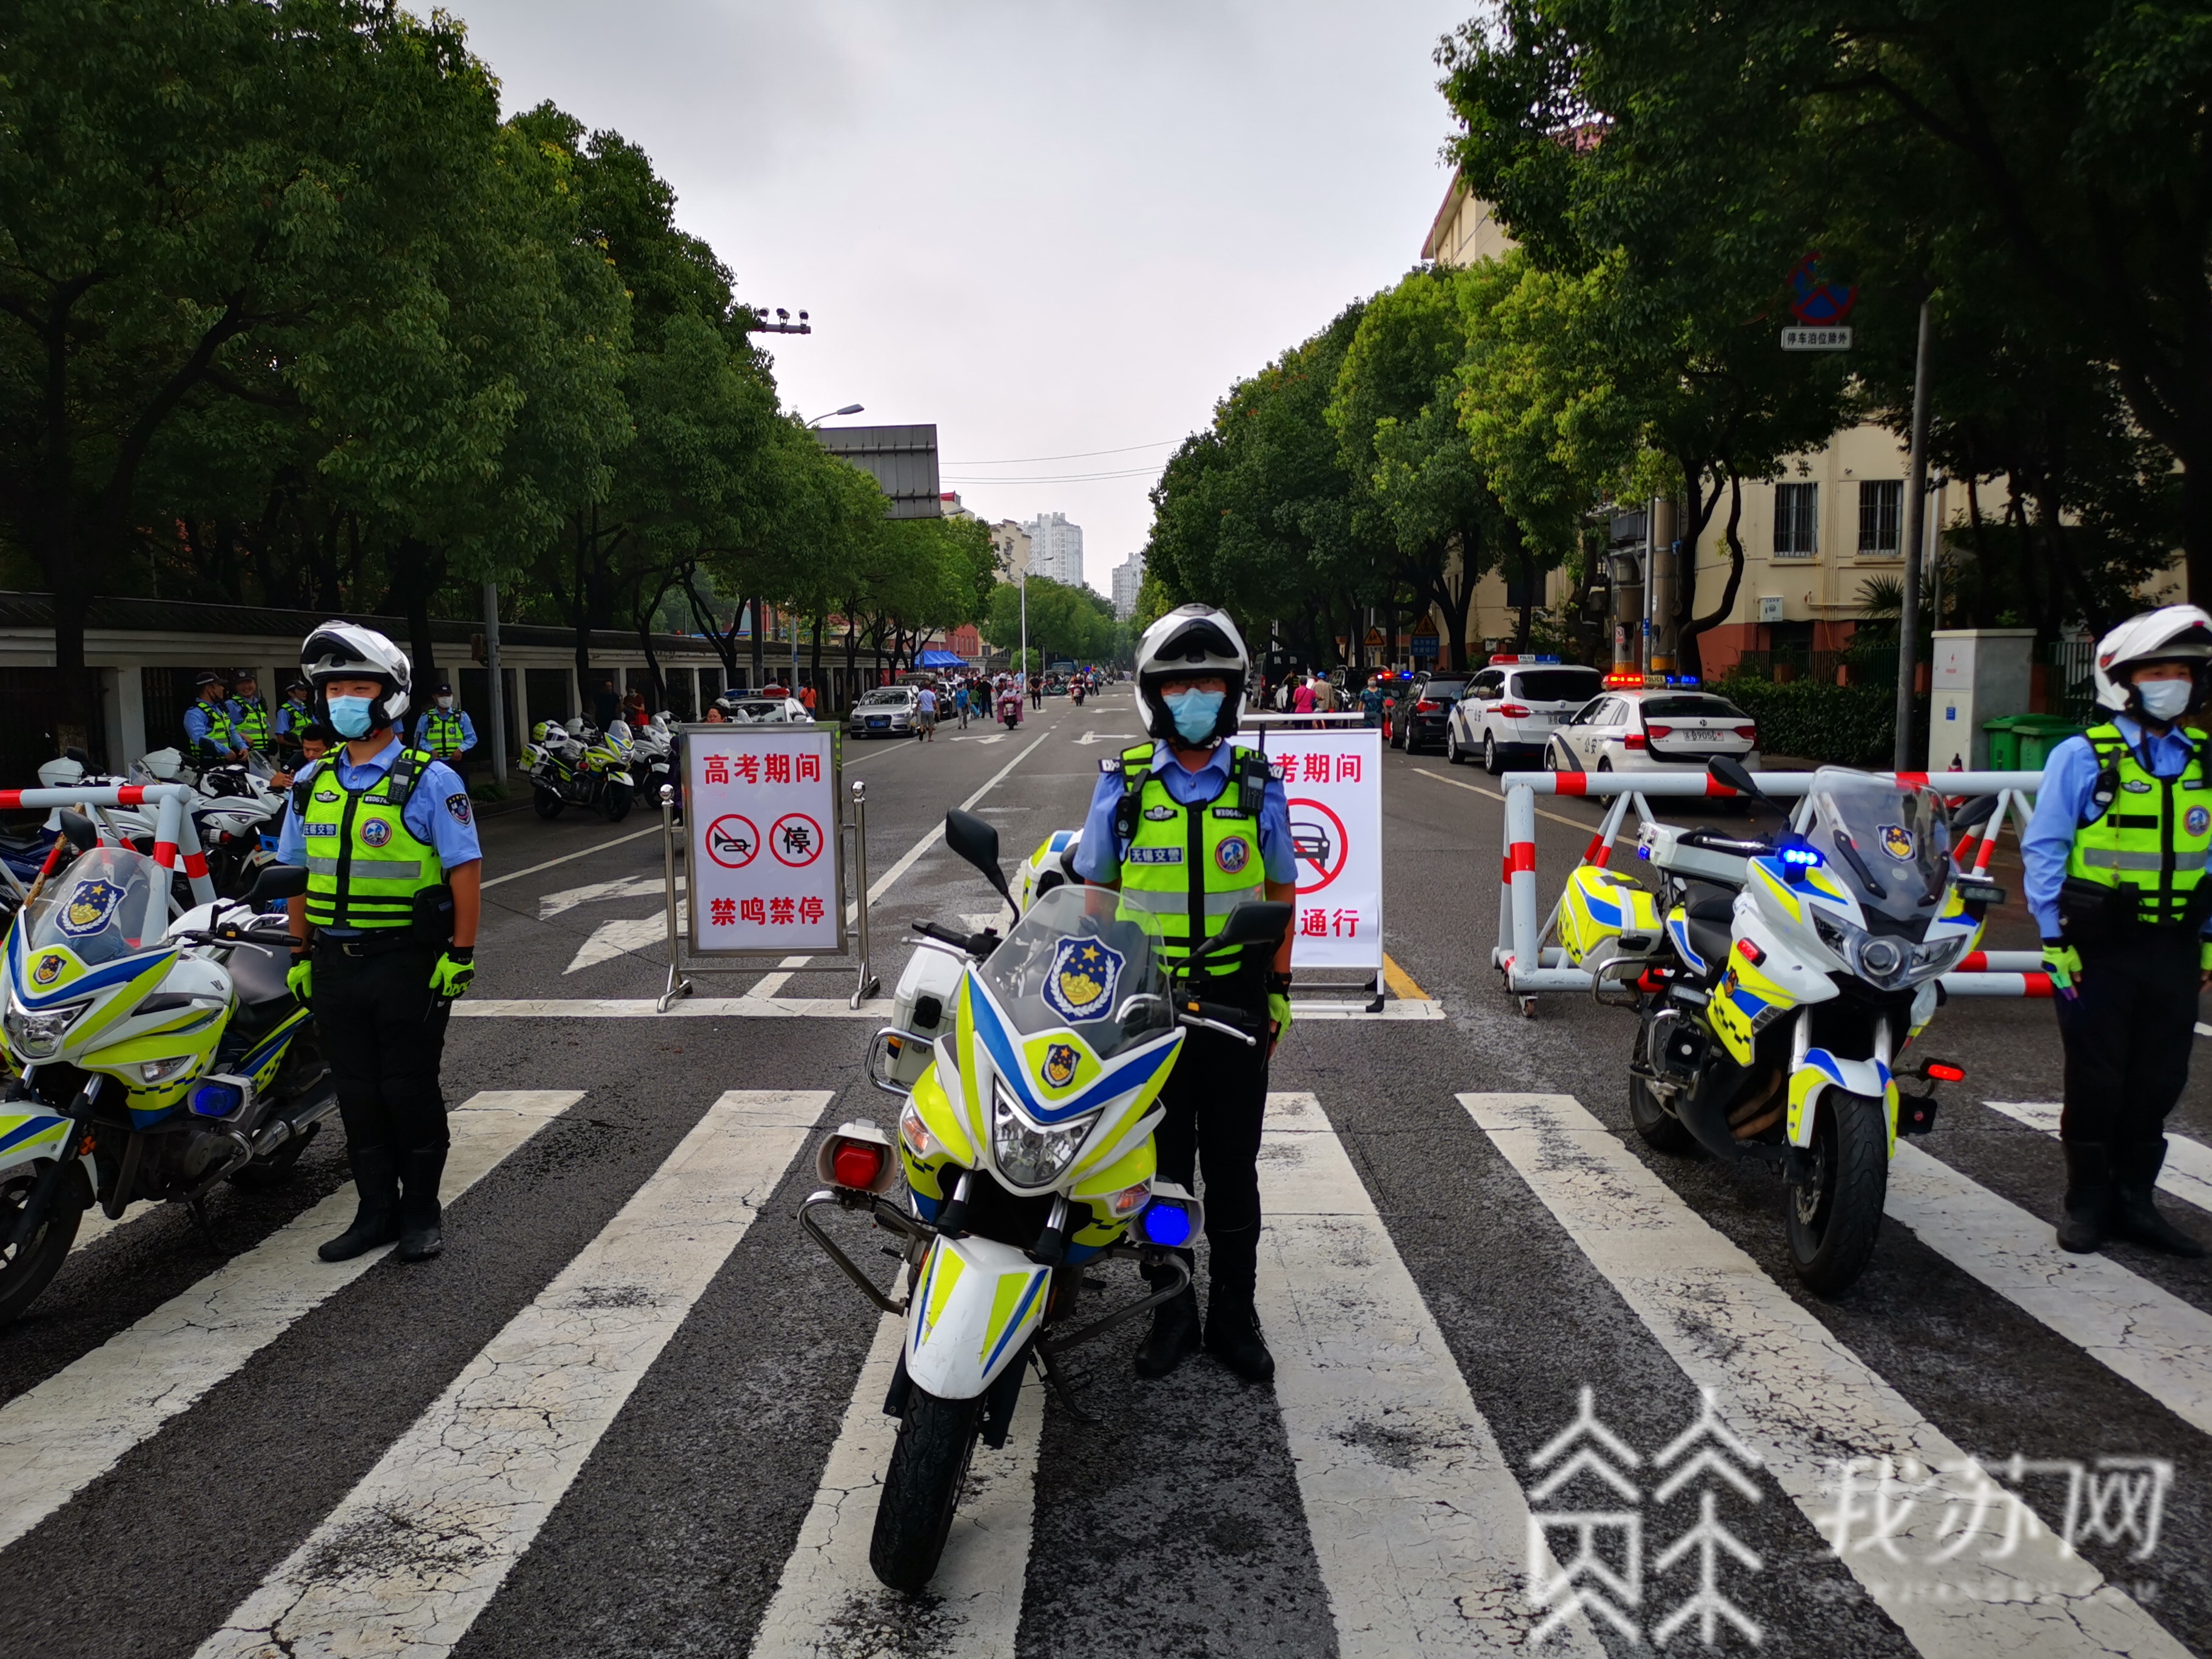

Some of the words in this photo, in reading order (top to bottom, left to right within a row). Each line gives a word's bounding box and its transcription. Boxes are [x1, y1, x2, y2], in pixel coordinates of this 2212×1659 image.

[1787, 332, 1847, 346] 停车泊位除外
[1584, 736, 1598, 755] 公安
[703, 753, 820, 785] 高考期间
[783, 826, 811, 854] 停
[1131, 848, 1180, 862] 无锡交警
[711, 896, 825, 926] 禁鸣禁停
[1295, 908, 1359, 937] 通行
